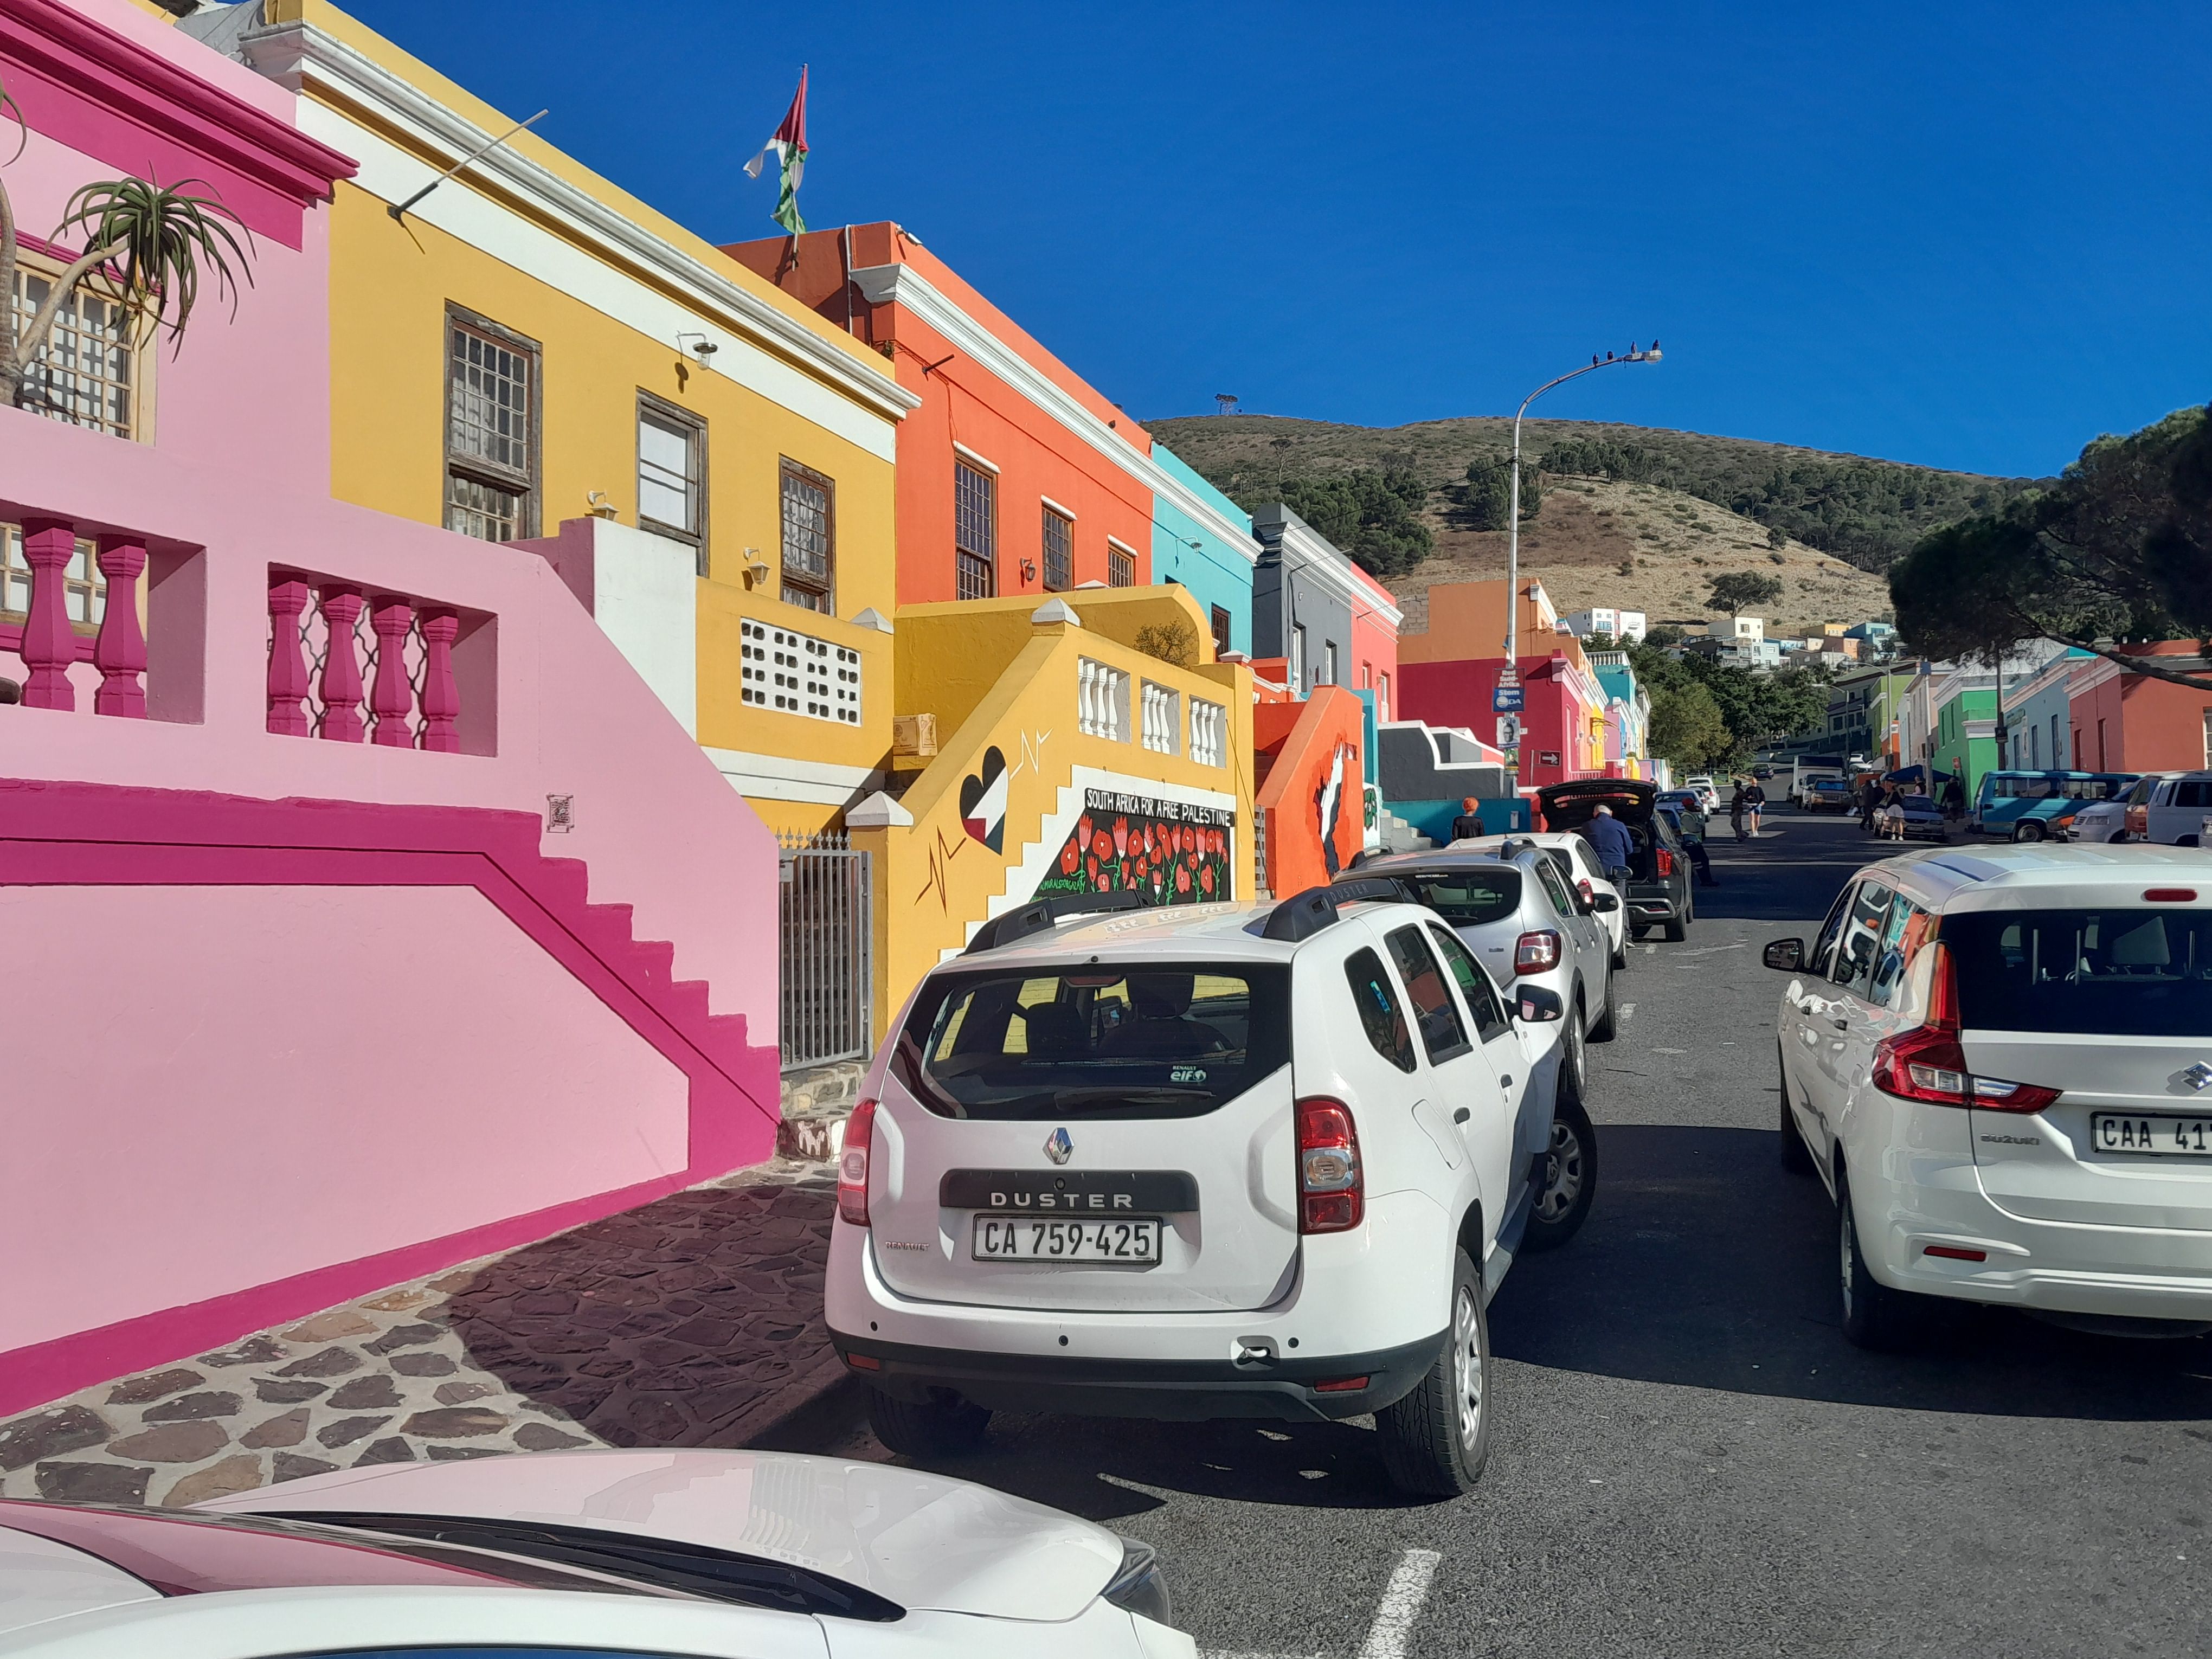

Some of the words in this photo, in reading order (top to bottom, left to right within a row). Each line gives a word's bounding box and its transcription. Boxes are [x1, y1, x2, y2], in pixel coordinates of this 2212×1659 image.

[1087, 789, 1113, 811] SOUTH
[1116, 794, 1139, 814] AFRICA
[1141, 798, 1154, 816] FOR
[1182, 805, 1230, 827] PALESTINE
[1329, 884, 1368, 901] DUSTER
[1170, 1071, 1194, 1081] elf
[1980, 1133, 2041, 1145] SUZUKI
[2103, 1120, 2152, 1148] CAA
[991, 1192, 1133, 1208] DUSTER
[885, 1241, 929, 1251] RENAULT
[985, 1223, 1017, 1254] CA
[1032, 1223, 1150, 1256] 759-425
